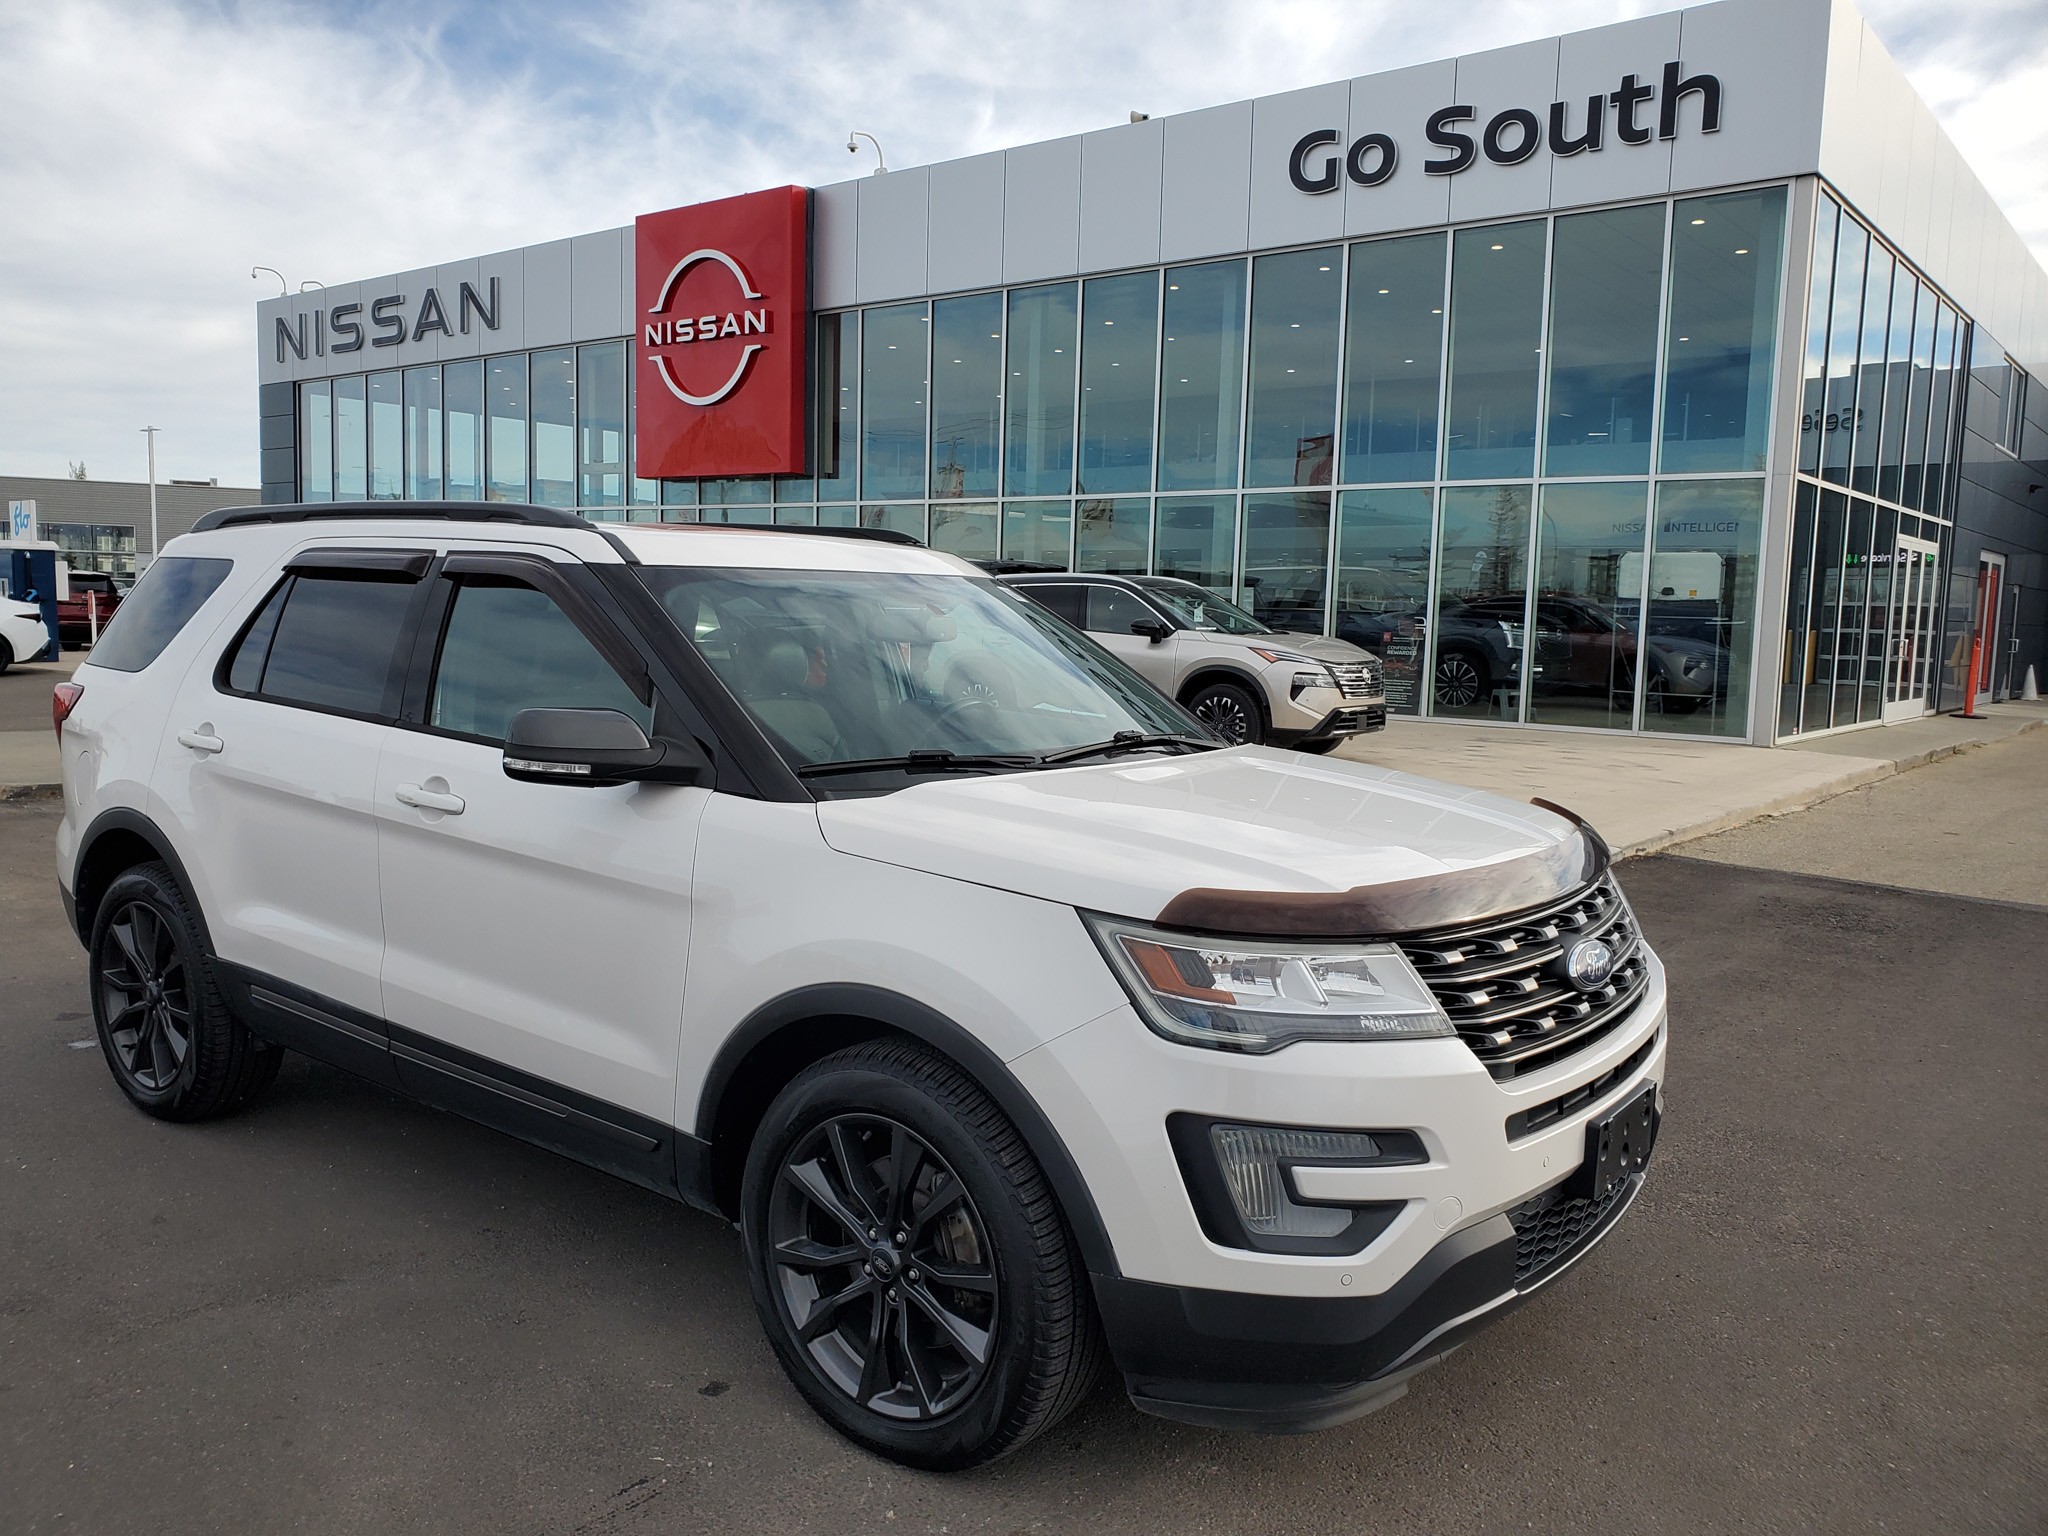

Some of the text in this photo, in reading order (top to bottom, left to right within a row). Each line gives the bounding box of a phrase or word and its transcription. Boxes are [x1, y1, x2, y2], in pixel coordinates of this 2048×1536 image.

[1288, 60, 1722, 195] Go South
[275, 276, 500, 363] NISSAN
[645, 309, 768, 346] NISSAN
[14, 501, 30, 536] flo
[1612, 523, 1646, 533] NISSA
[1586, 948, 1611, 976] Ford
